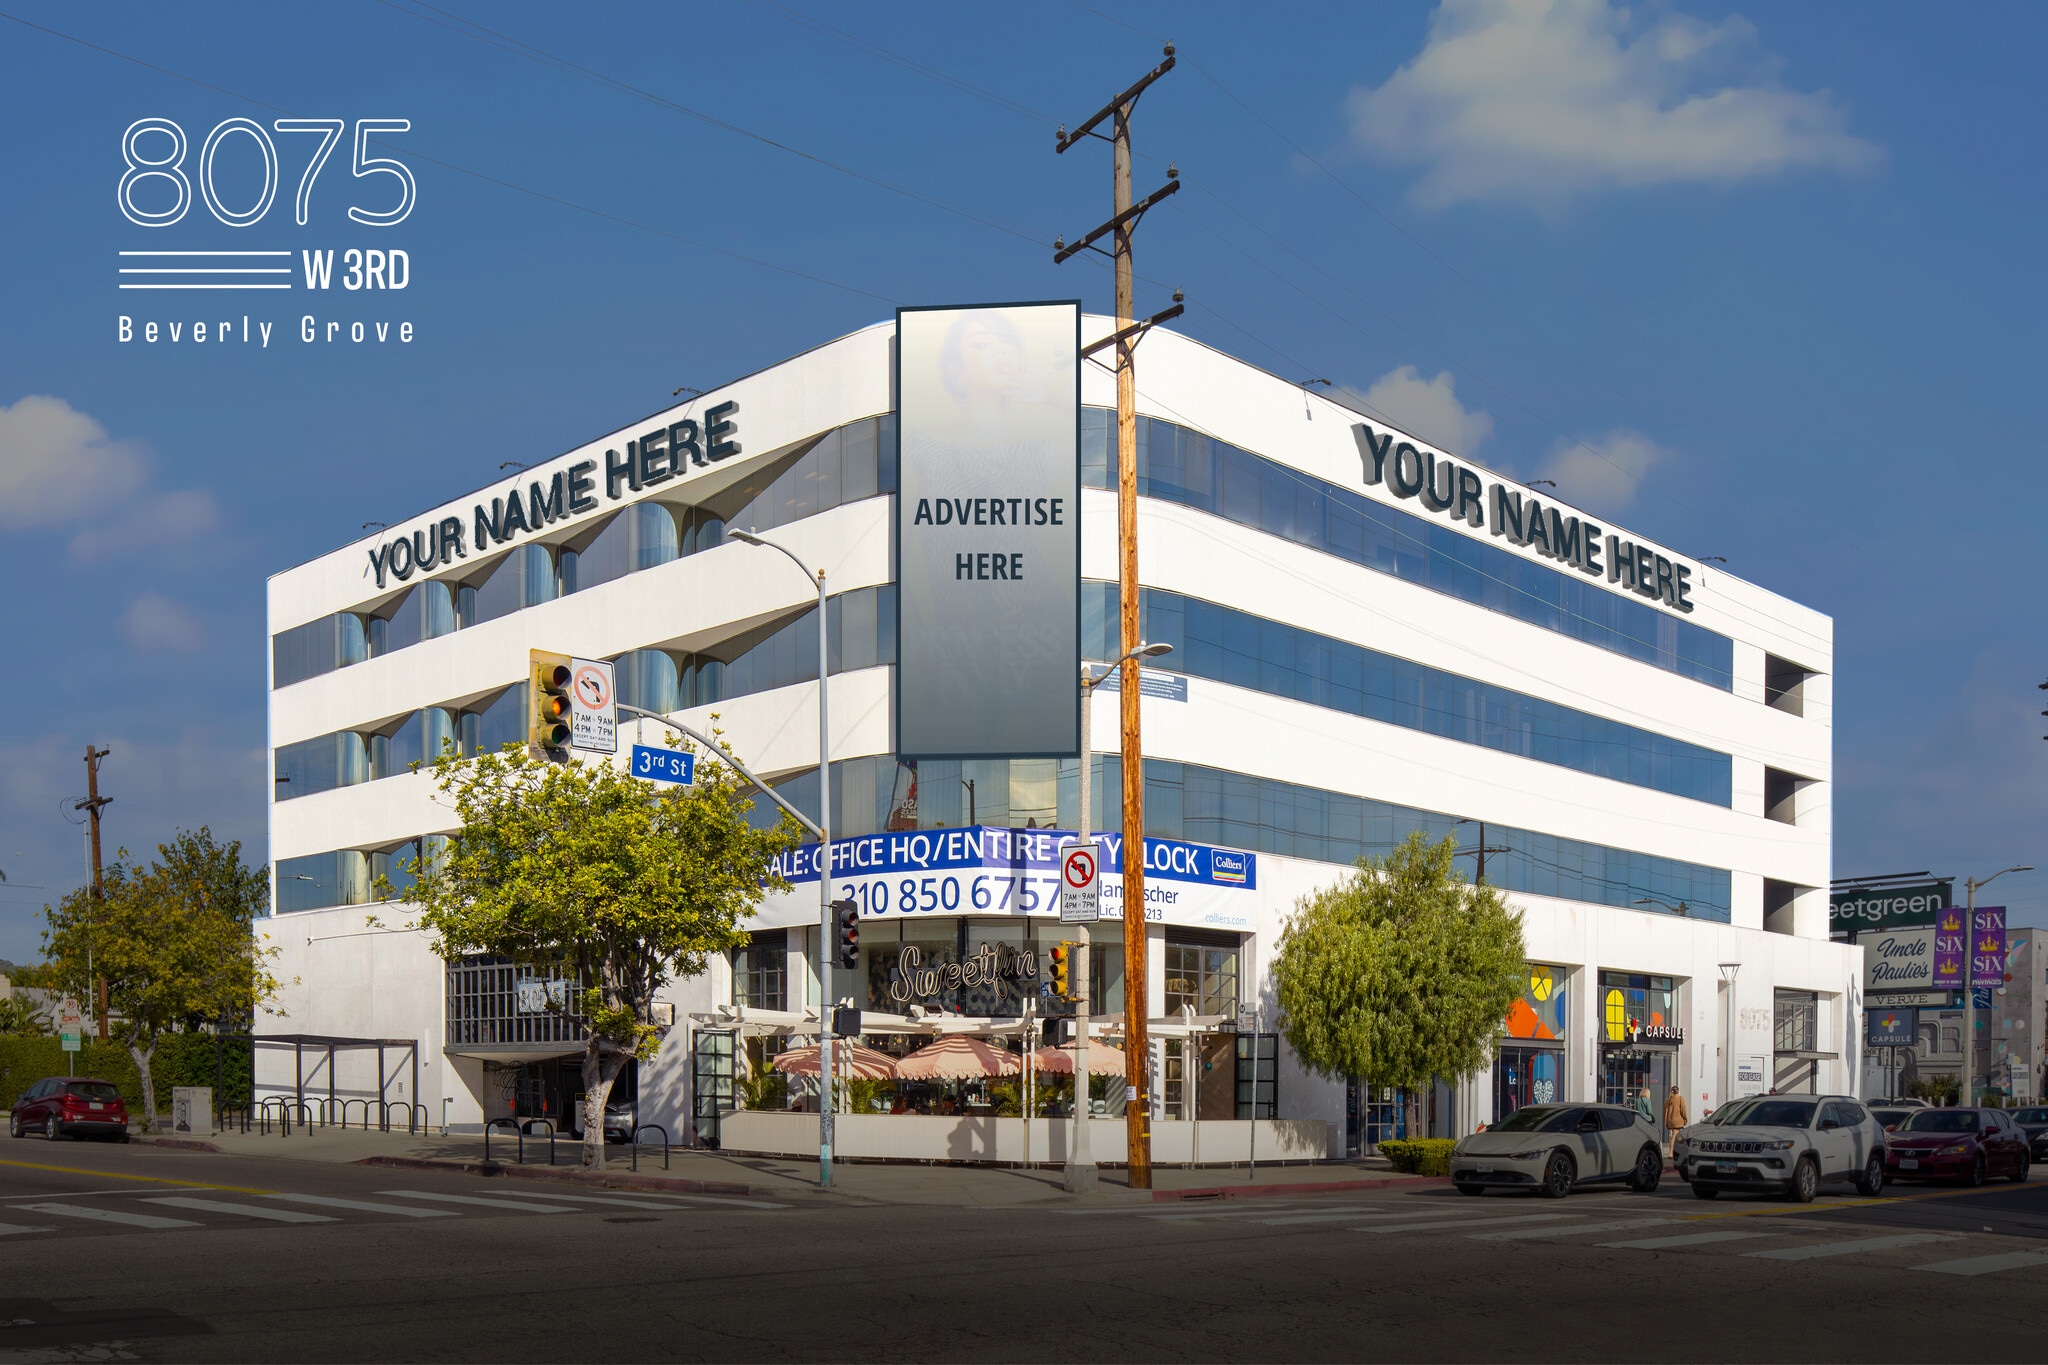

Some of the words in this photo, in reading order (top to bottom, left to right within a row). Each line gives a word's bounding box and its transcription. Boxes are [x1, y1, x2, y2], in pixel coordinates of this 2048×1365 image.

[368, 516, 467, 589] YOUR
[474, 458, 599, 550] NAME
[605, 400, 742, 500] HERE
[914, 498, 1064, 526] ADVERTISE
[1350, 422, 1485, 529] YOUR
[1489, 483, 1604, 577] NAME
[1605, 534, 1695, 614] HERE
[955, 553, 1024, 581] HERE
[640, 751, 665, 773] 3rd
[670, 758, 687, 777] St
[1142, 842, 1200, 876] LOCK
[1215, 855, 1243, 870] Colliers
[841, 880, 889, 915] 310
[899, 876, 960, 912] 850
[971, 874, 1061, 911] 6757
[1205, 912, 1247, 926] colliers.com
[1877, 937, 1927, 958] Uncle
[891, 941, 1037, 1001] Sweetfin
[1872, 961, 1930, 985] Paulie's
[1875, 994, 1928, 1005] VERVE
[1646, 1025, 1687, 1039] CAPSULE
[1739, 1008, 1770, 1032] 8075
[1871, 1035, 1911, 1043] CAPSULE
[1739, 1072, 1749, 1081] FOR
